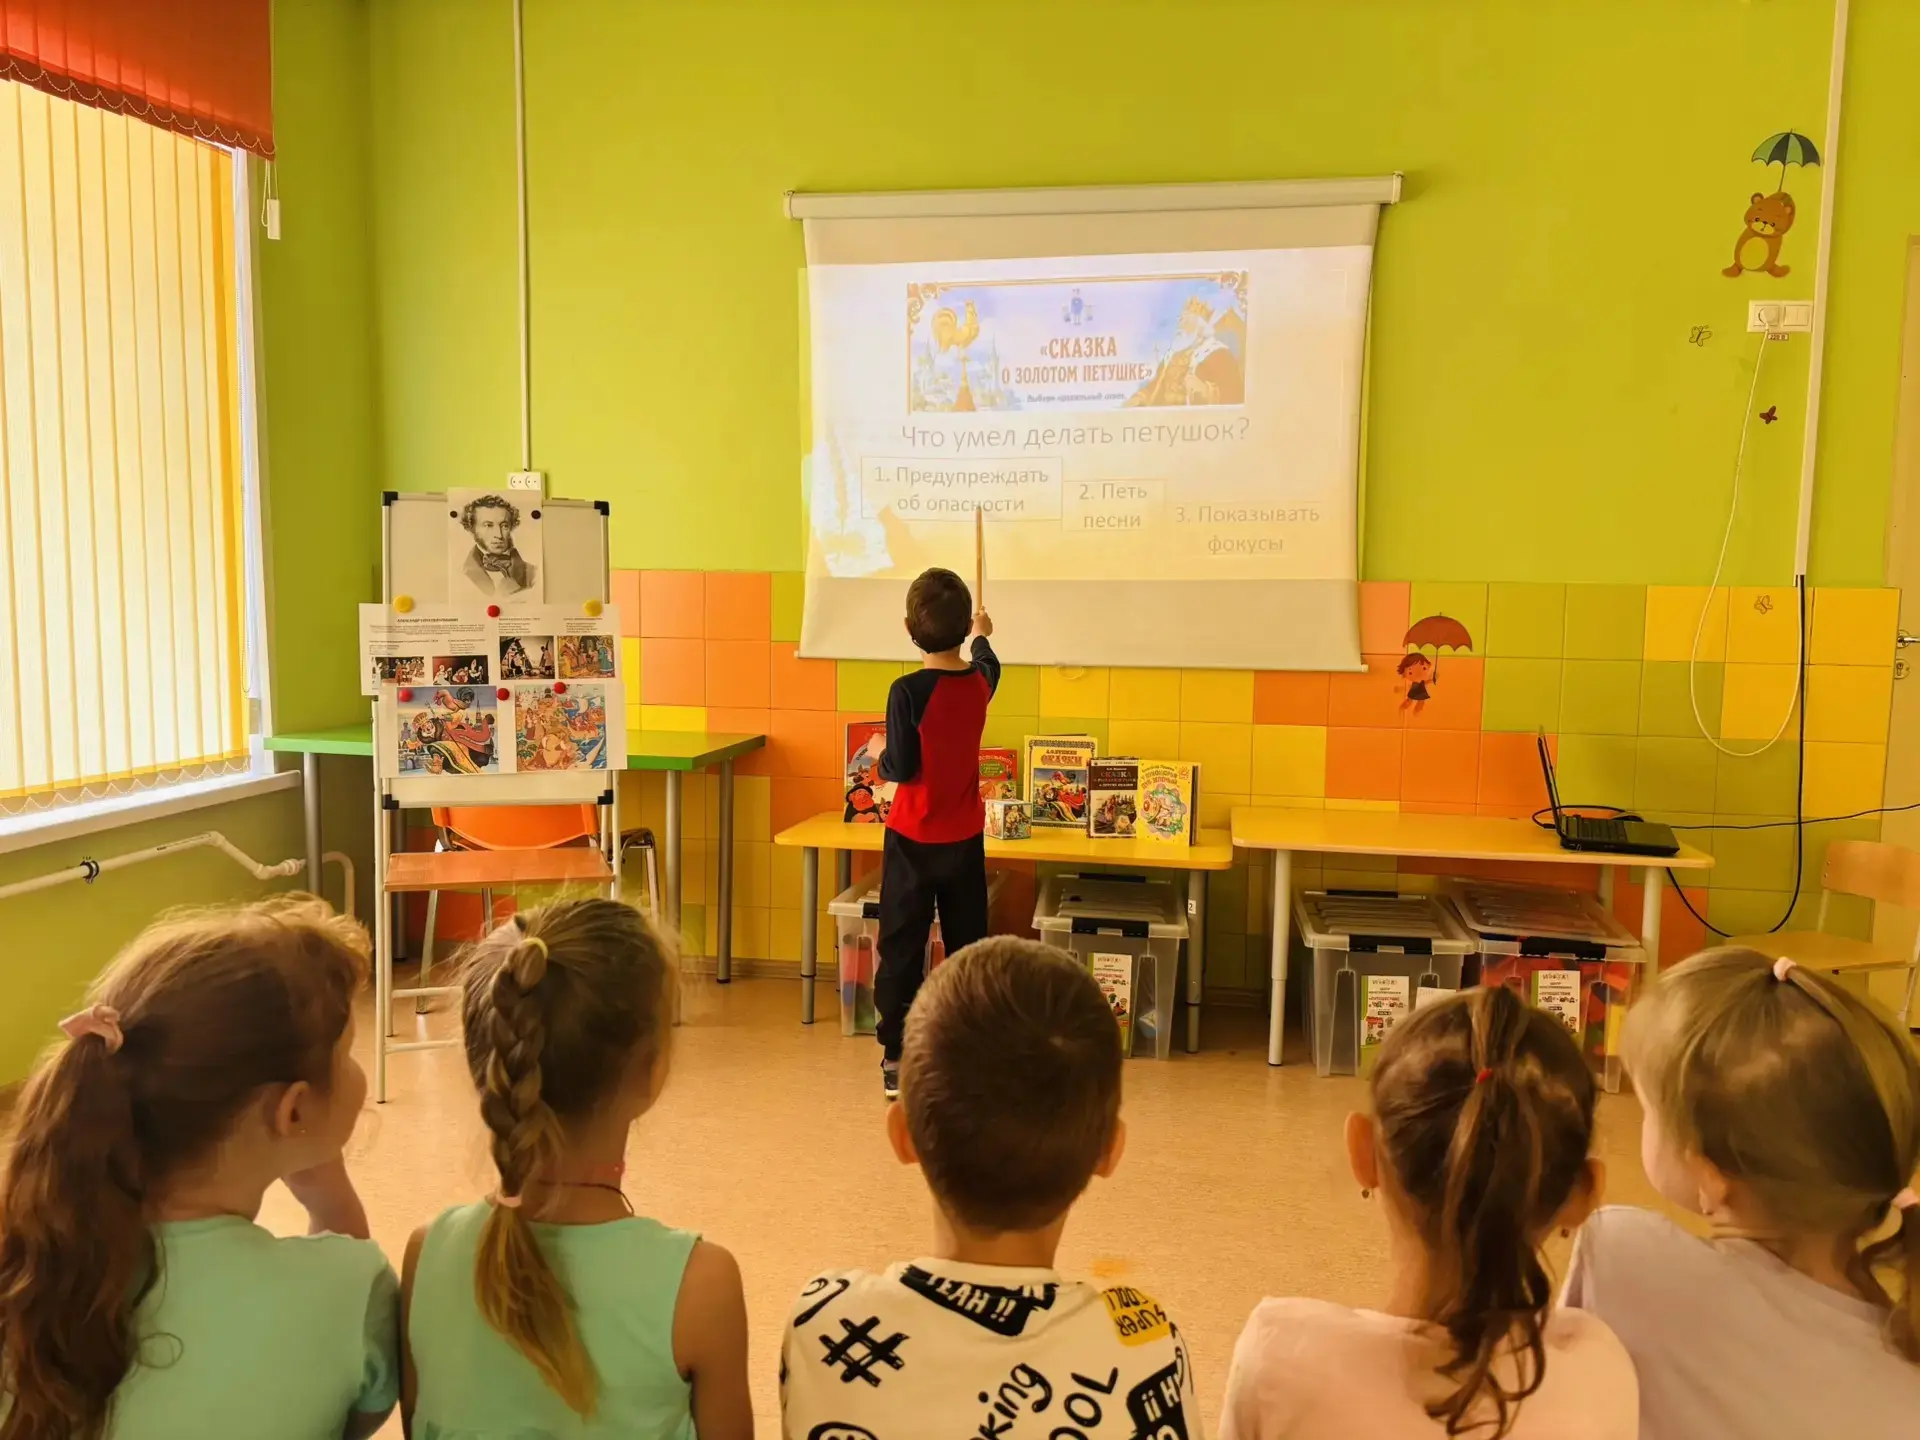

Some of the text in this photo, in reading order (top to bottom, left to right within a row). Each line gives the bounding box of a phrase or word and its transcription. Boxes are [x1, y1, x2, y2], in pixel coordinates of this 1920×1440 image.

[1040, 336, 1118, 359] «СКАЗКА
[1001, 362, 1153, 385] О ЗОЛОТОМ ПЕТУШКЕ»
[901, 416, 1250, 452] Что умел делать петушок?
[874, 465, 1049, 488] 1. Предупреждать
[1078, 482, 1148, 501] 2. Петь
[897, 494, 1026, 513] об опасности
[1083, 514, 1142, 529] песни
[1175, 505, 1321, 524] 3. Показывать
[1207, 535, 1284, 555] фокусы
[1189, 902, 1193, 911] 2
